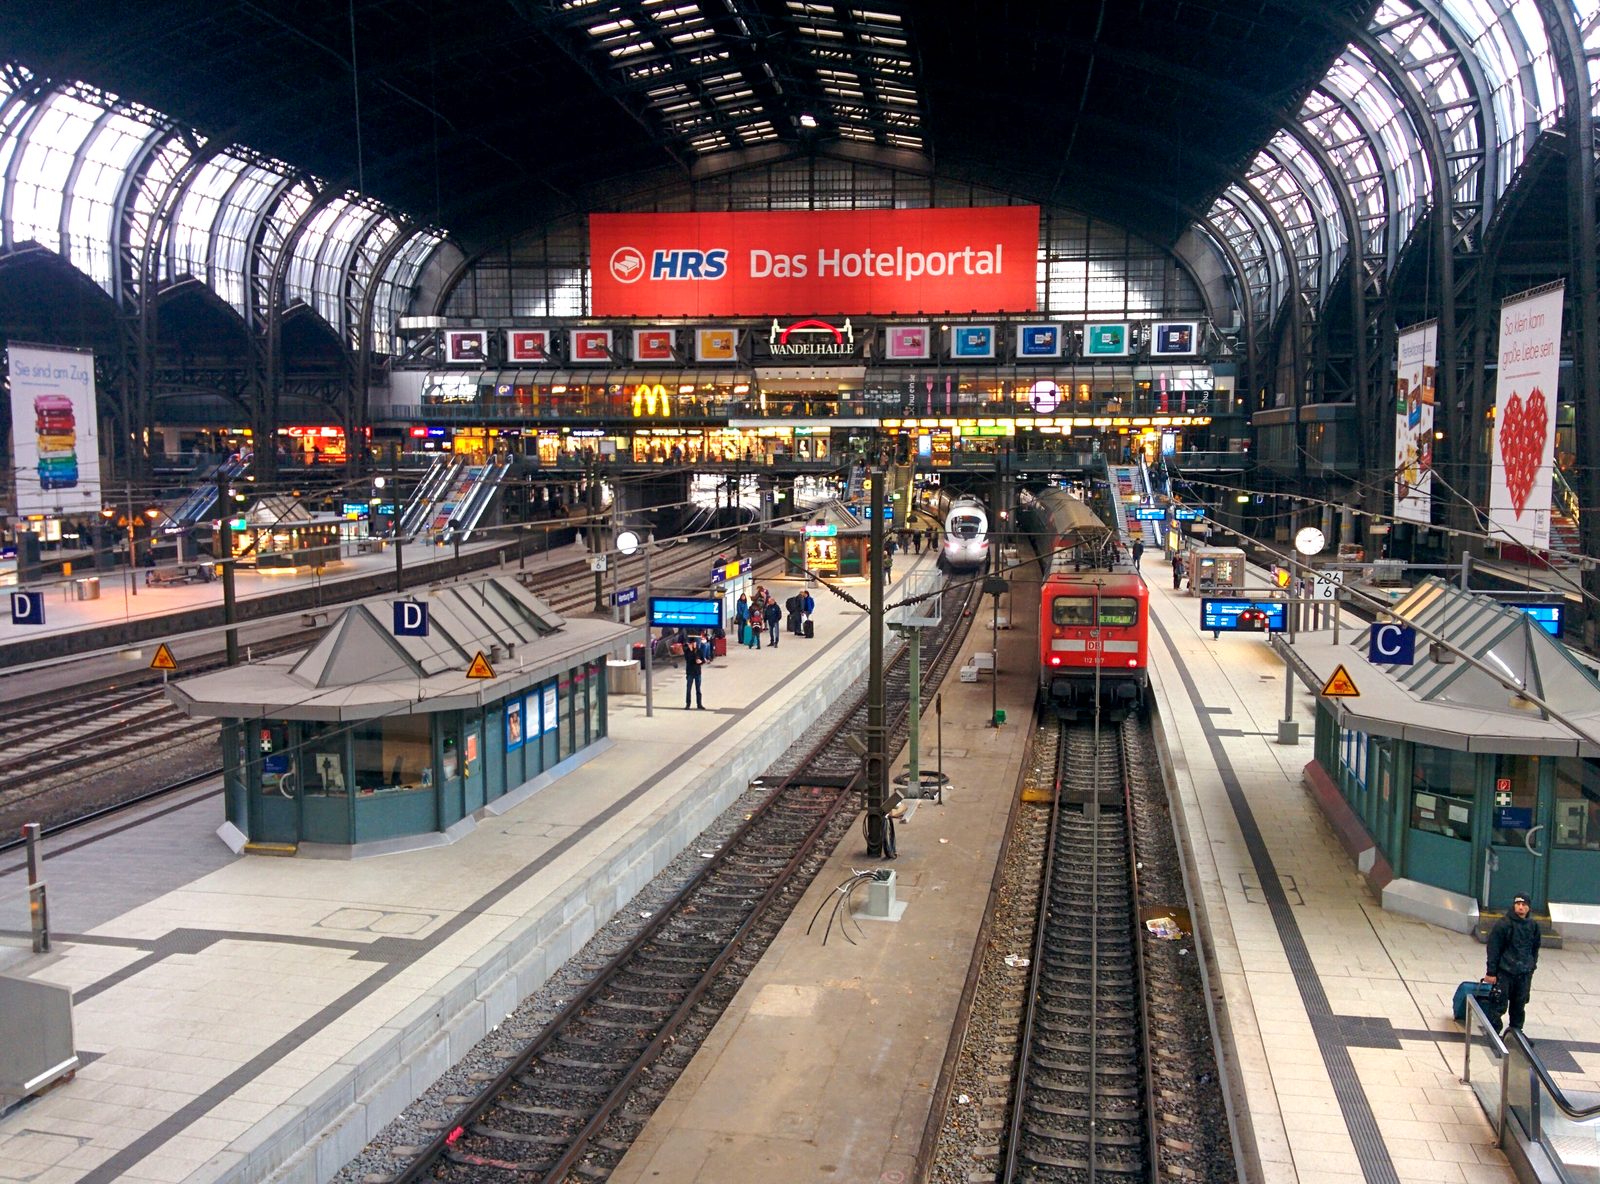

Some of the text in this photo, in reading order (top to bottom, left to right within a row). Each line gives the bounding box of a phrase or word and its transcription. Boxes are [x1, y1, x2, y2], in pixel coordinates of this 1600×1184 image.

[650, 244, 1003, 281] HRS Das Hotelportal
[770, 343, 854, 354] WANDELHALLE
[14, 360, 30, 377] Sie
[32, 362, 51, 378] sind
[54, 367, 68, 379] am
[1323, 586, 1332, 598] 6
[14, 593, 31, 618] D
[1206, 603, 1212, 612] 6
[404, 602, 422, 629] D
[1088, 641, 1101, 650] DB
[1377, 624, 1402, 656] C
